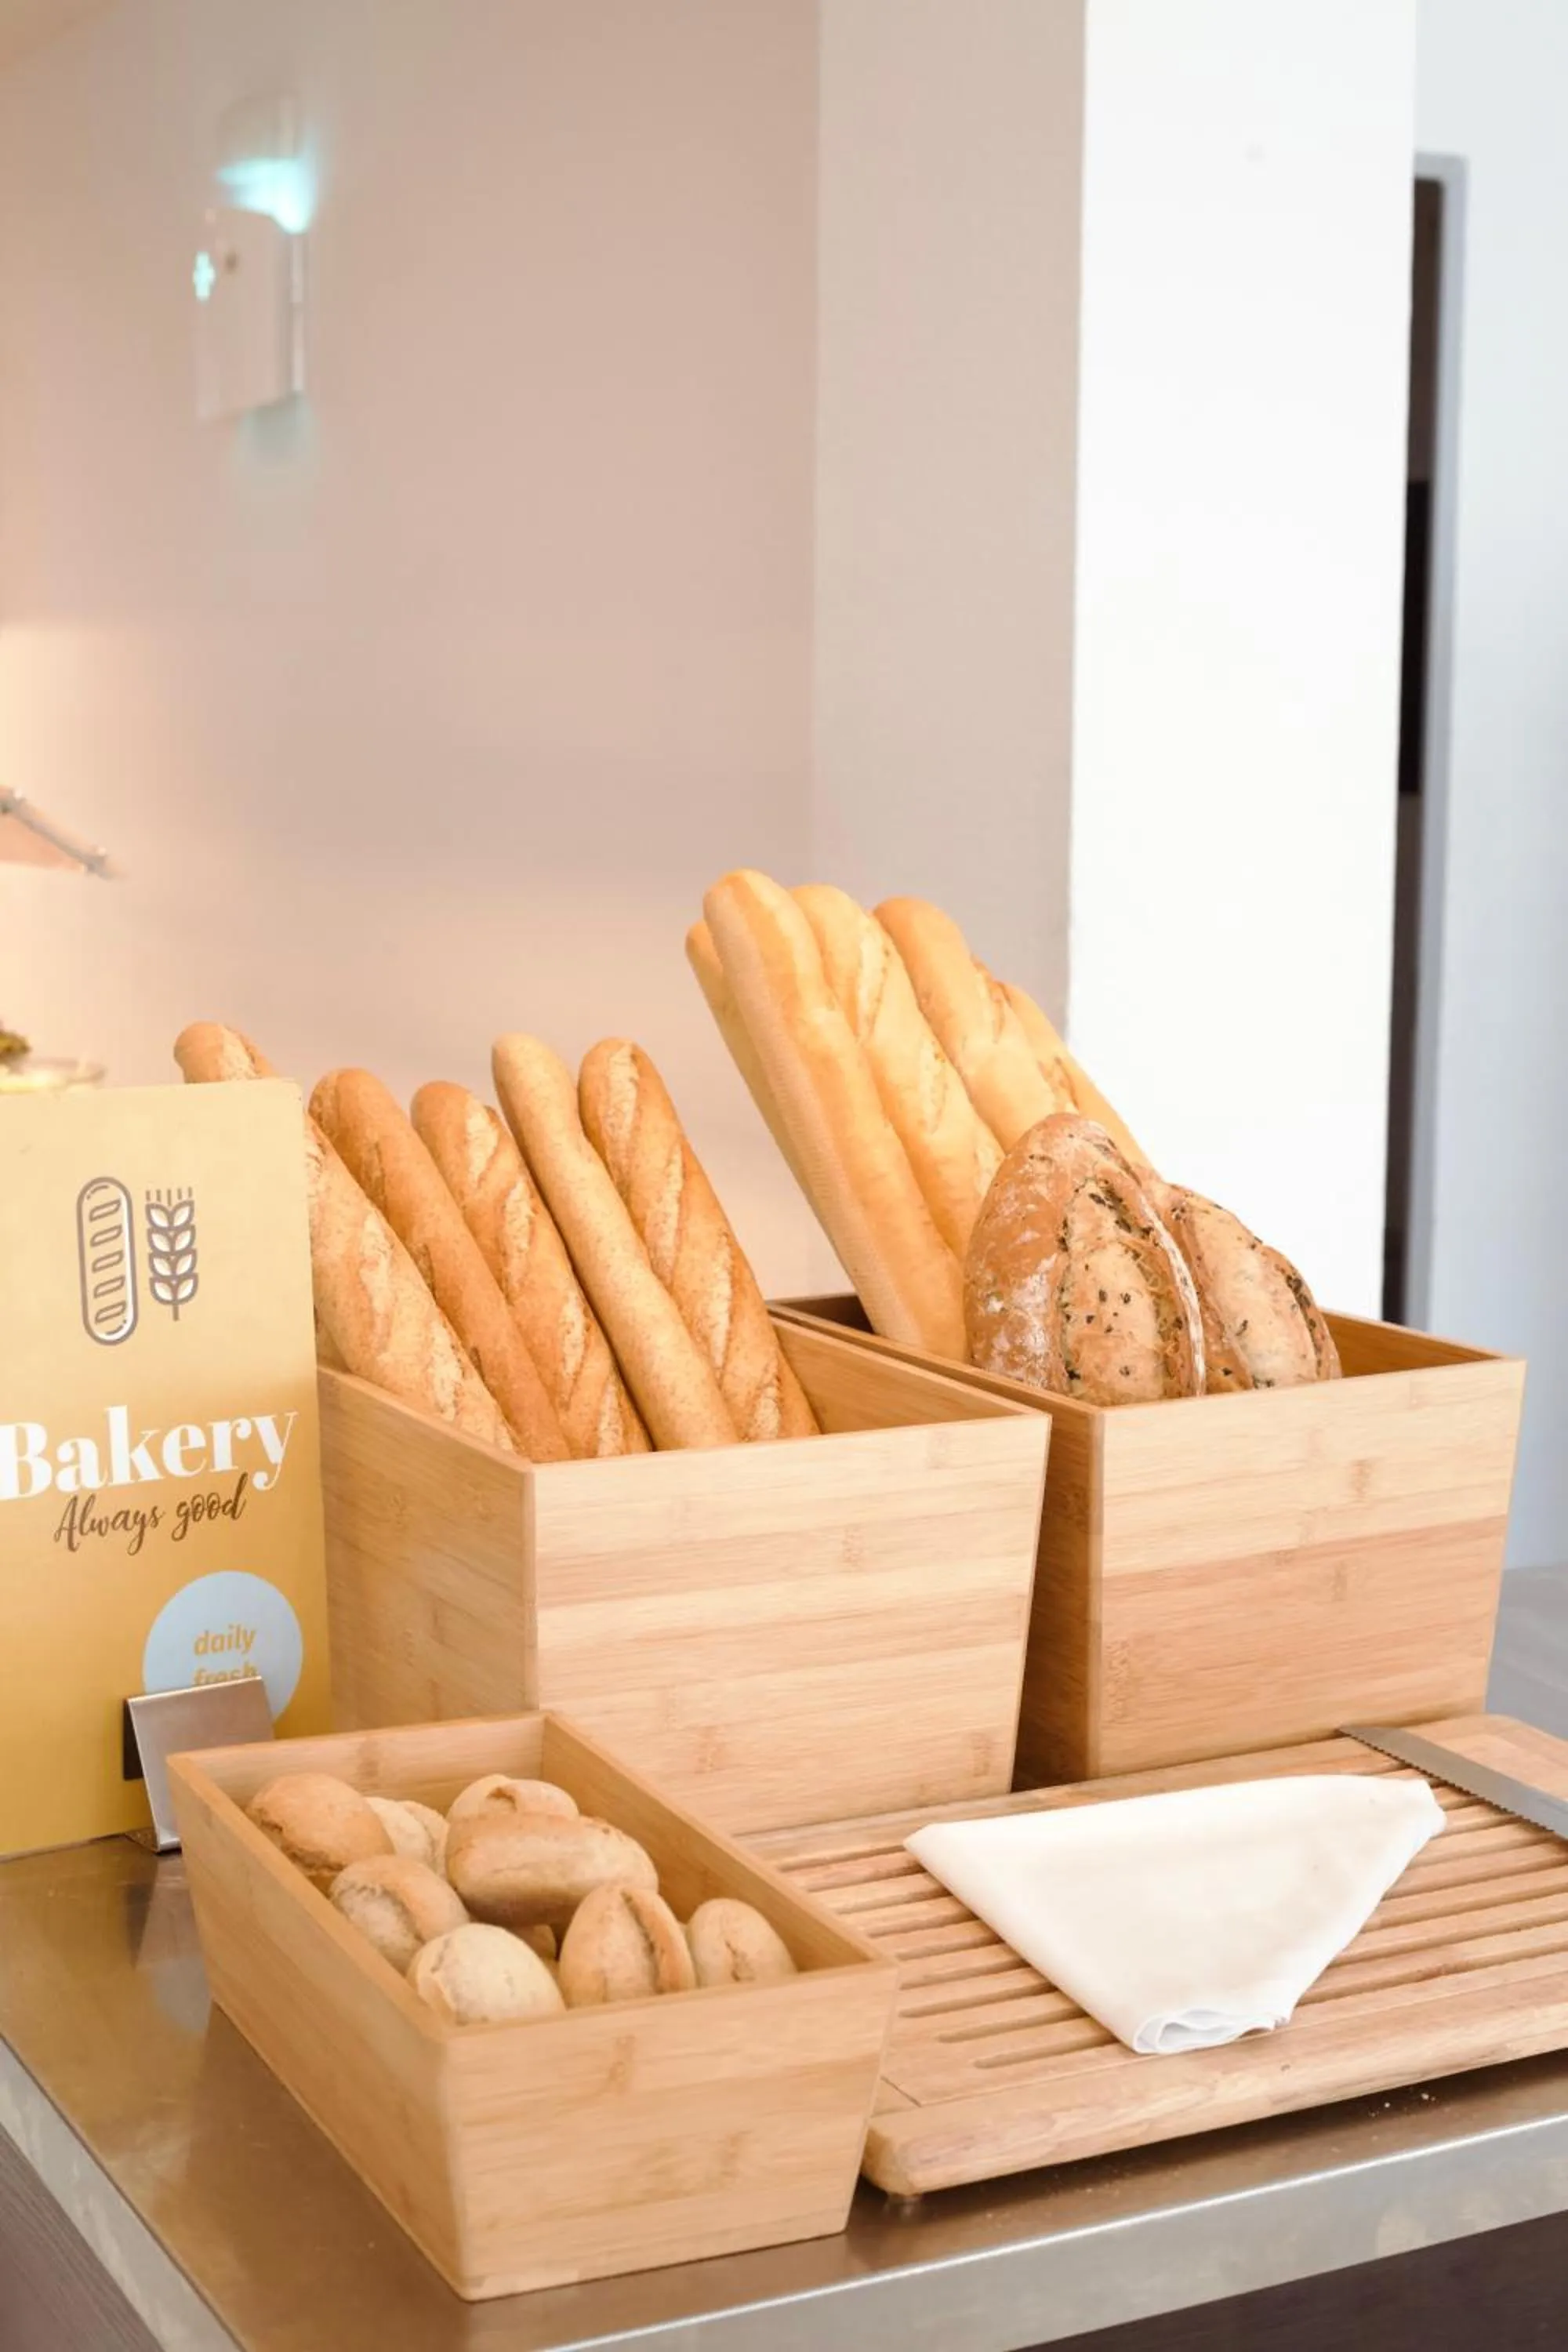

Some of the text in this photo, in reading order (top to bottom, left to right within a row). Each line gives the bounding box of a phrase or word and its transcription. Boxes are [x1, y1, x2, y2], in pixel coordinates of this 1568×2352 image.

[0, 1405, 299, 1500] Bakery
[53, 1472, 248, 1555] Always good
[194, 1624, 256, 1656] daily
